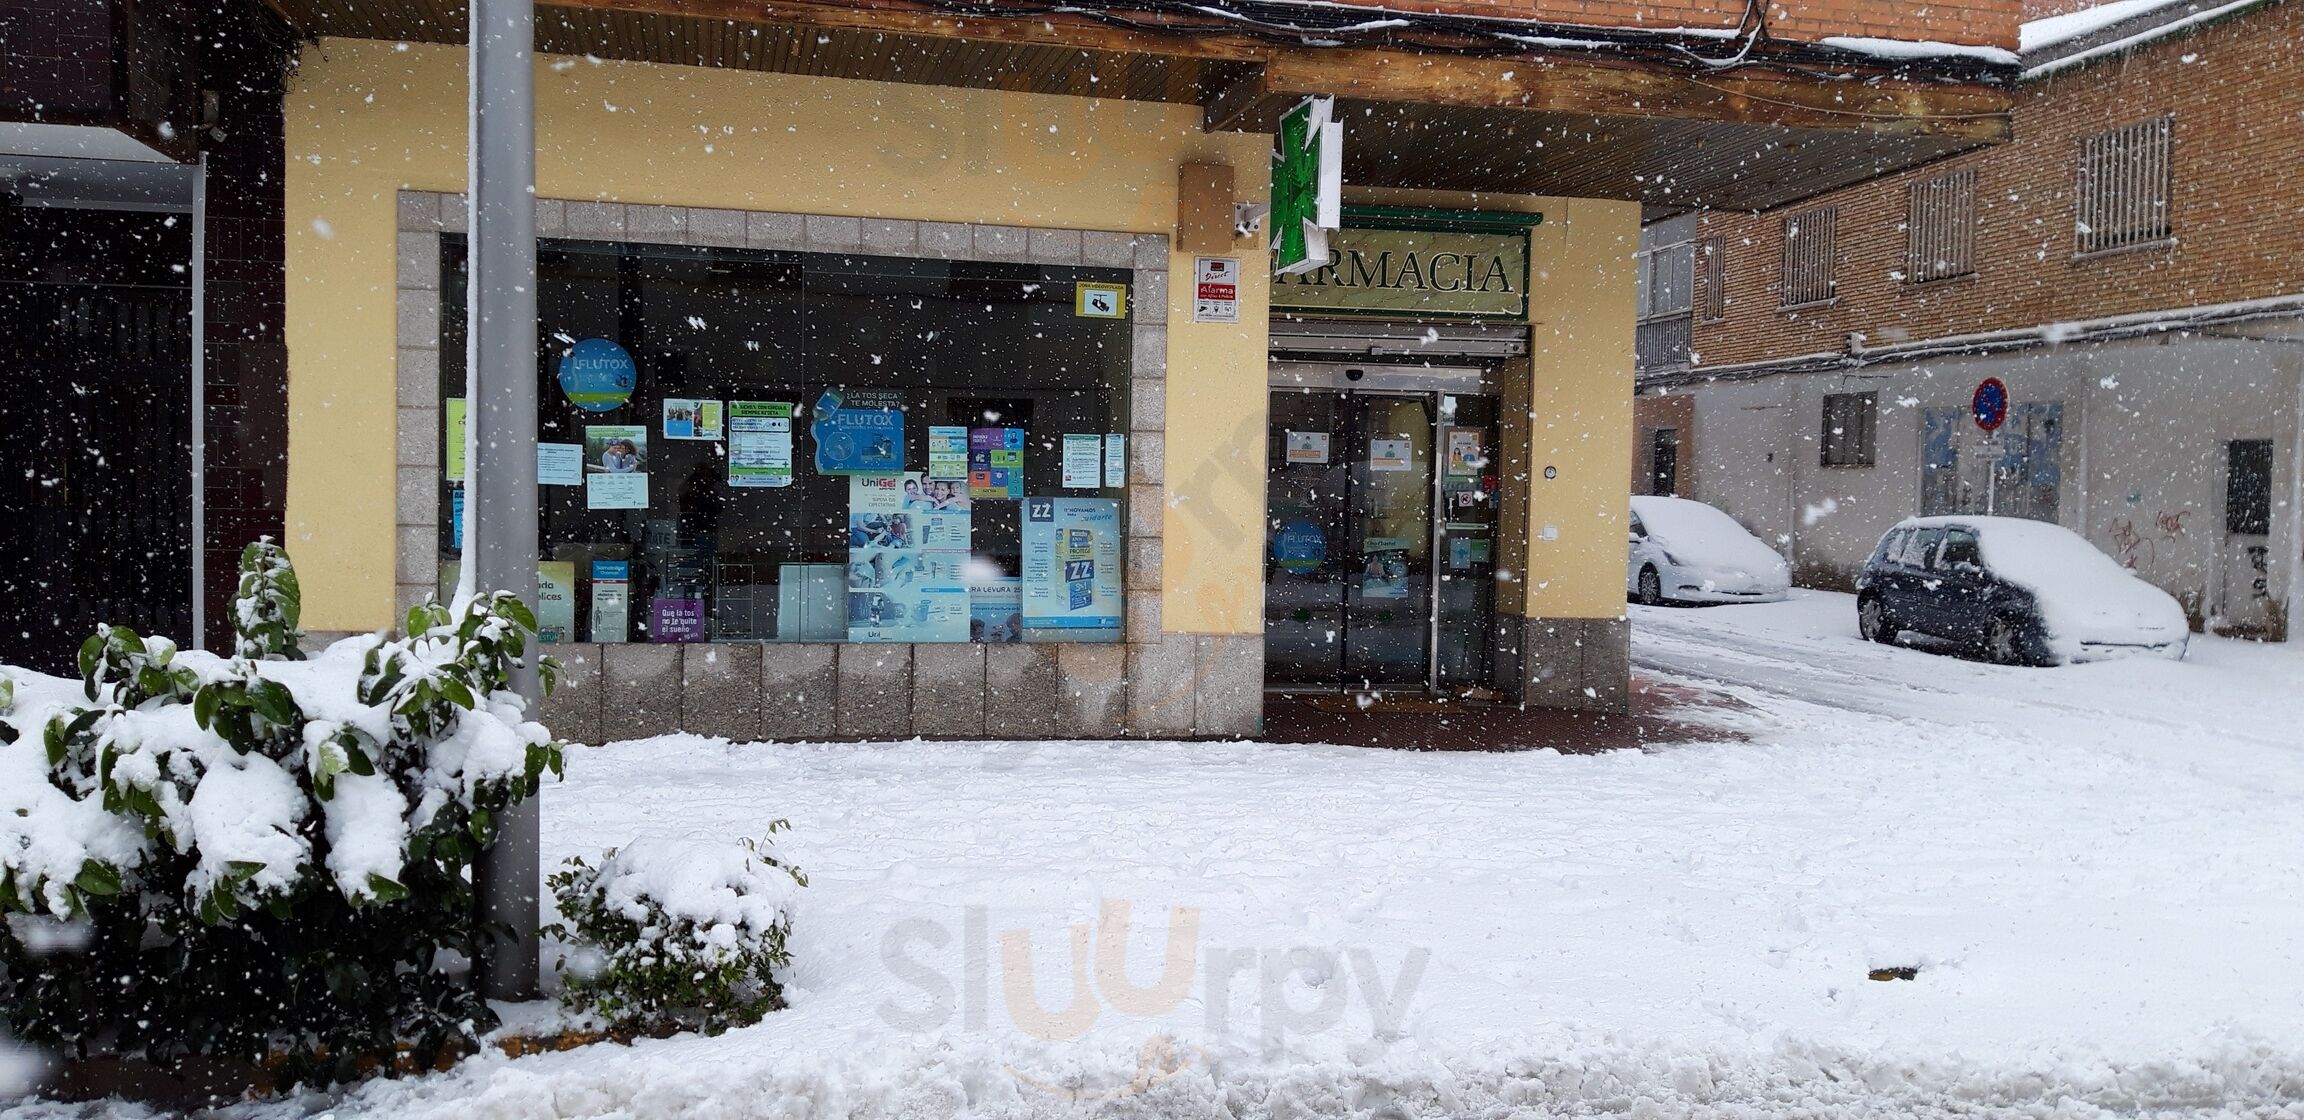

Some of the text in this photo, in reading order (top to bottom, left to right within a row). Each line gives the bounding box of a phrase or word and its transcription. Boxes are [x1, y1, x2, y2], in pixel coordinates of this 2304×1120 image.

[1270, 249, 1515, 294] RMACIA
[1200, 285, 1234, 295] Alarma
[579, 359, 628, 370] FLUTOX
[879, 392, 898, 400] SECA
[861, 400, 900, 408] MOLESTA?
[837, 414, 894, 426] FLUTOX
[1032, 503, 1051, 518] ZZ
[1070, 561, 1091, 580] ZZ
[661, 609, 695, 617] Que la tos
[680, 617, 697, 626] quite
[661, 625, 668, 633] el
